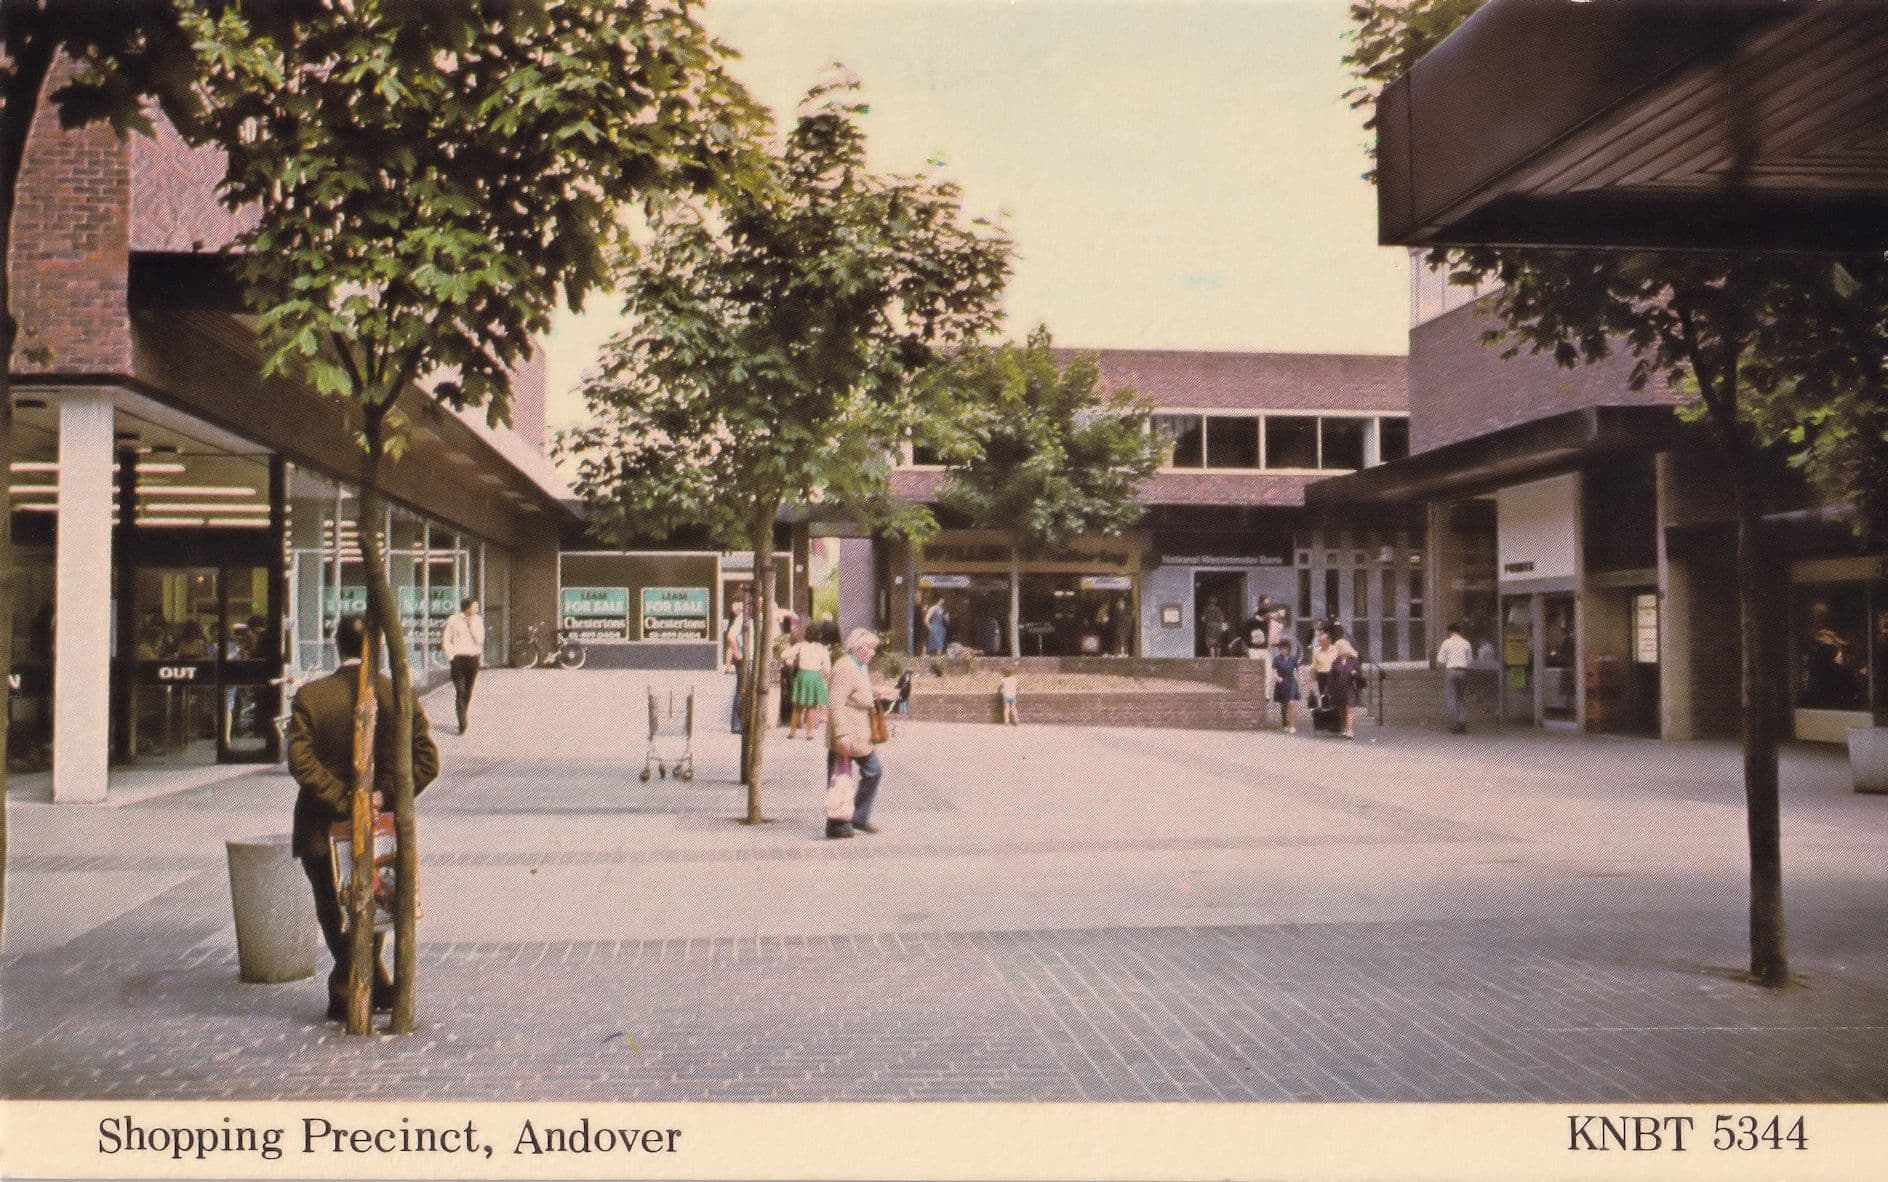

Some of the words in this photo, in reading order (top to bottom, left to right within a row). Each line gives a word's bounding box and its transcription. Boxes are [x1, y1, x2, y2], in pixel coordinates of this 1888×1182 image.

[581, 592, 608, 600] LEASE
[661, 592, 688, 600] LEASE
[564, 600, 591, 611] FOR
[593, 600, 624, 611] SALE
[645, 600, 671, 611] FOR
[674, 600, 703, 611] SALE
[158, 667, 197, 680] OUT
